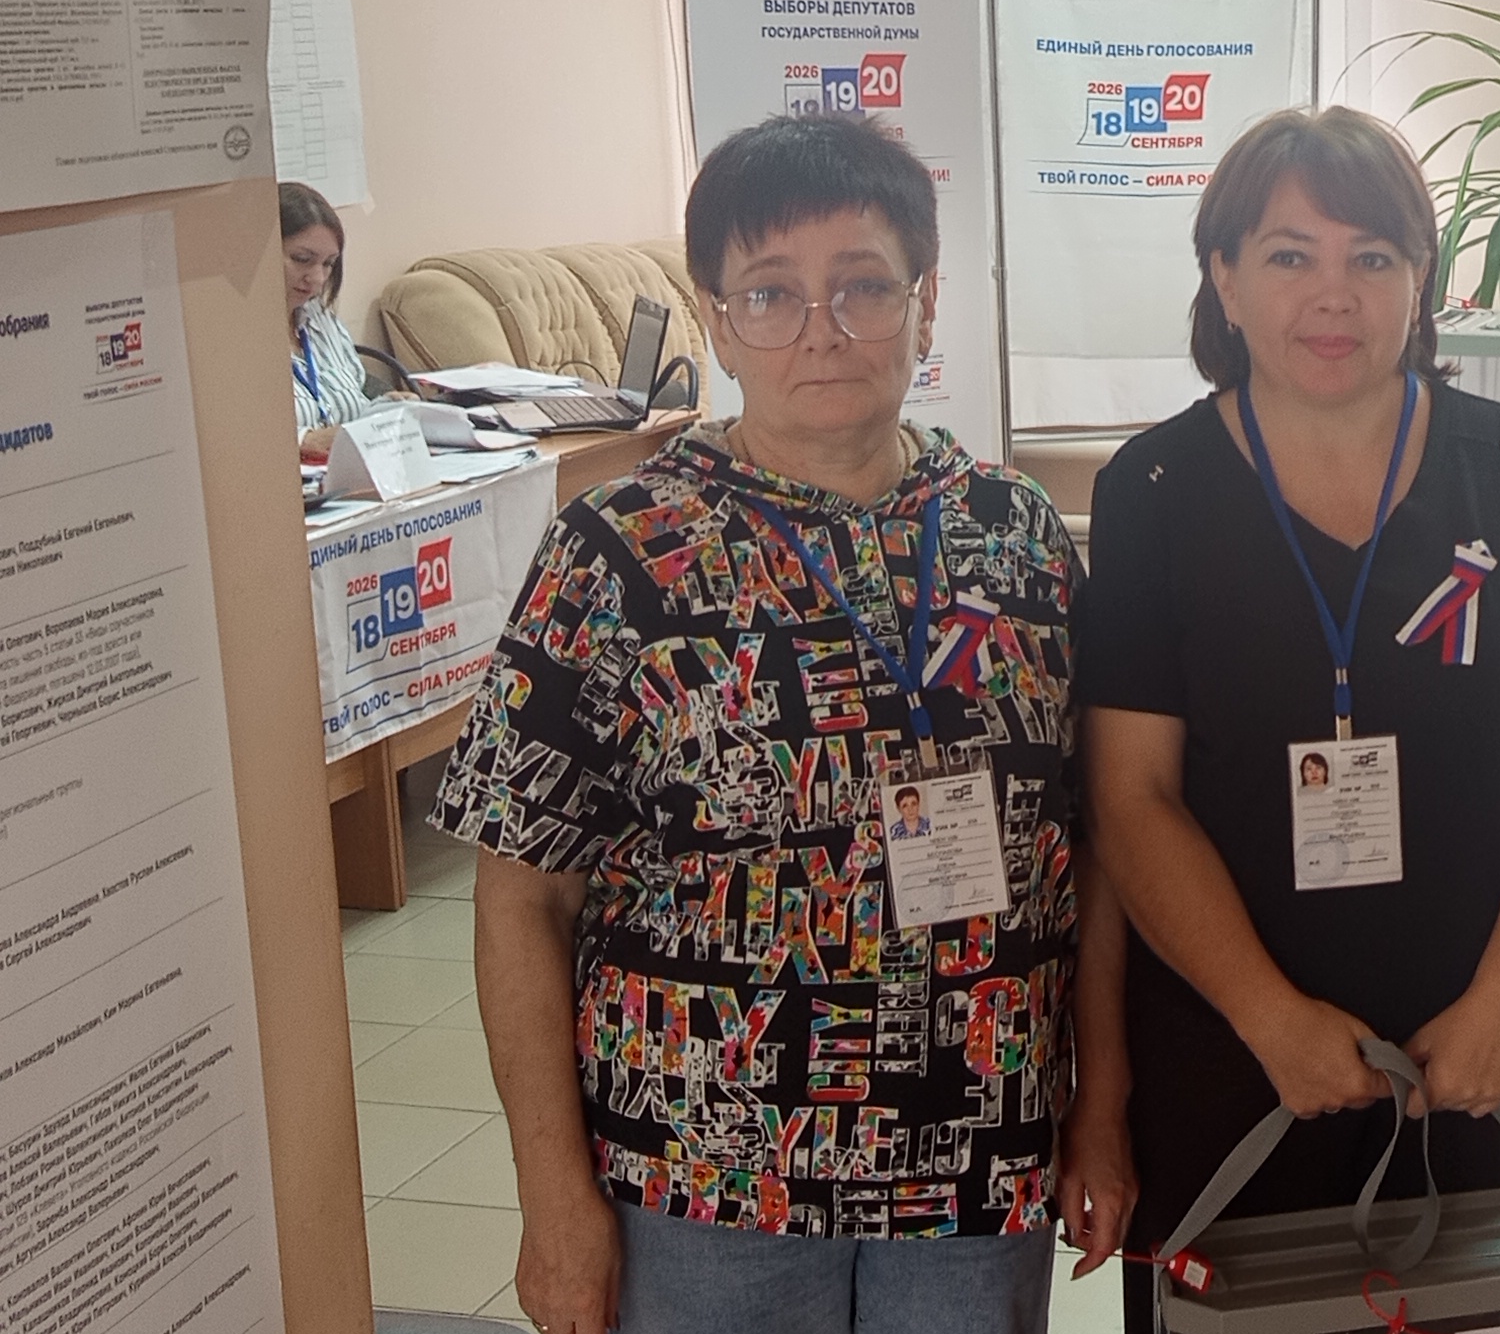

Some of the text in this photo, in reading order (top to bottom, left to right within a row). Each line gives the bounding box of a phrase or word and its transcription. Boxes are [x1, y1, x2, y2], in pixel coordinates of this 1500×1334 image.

[764, 0, 915, 16] ВЫБОРЫ ДЕПУТАТОВ
[762, 26, 919, 40] ГОСУДАРСТВЕННОЙ ДУМЫ
[1036, 39, 1253, 57] ЕДИНЫЙ ДЕНЬ ГОЛОСОВАНИЯ
[785, 66, 819, 78] 2026
[826, 81, 856, 111] 19
[862, 66, 898, 96] 20
[1087, 83, 1123, 95] 2026
[1091, 85, 1201, 136] 18 19 20
[1131, 137, 1203, 149] СЕНТЯБРЯ
[1038, 170, 1076, 184] ТВОЙ
[1079, 173, 1129, 186] ГОЛОС
[1146, 174, 1184, 187] СИЛА
[99, 328, 139, 367] 18 19 20
[310, 500, 483, 569] ДИНЫЙ ДЕНЬ ГОЛОСОВАНИЯ
[347, 574, 378, 597] 2026
[352, 556, 448, 653] 18 19 20
[390, 622, 456, 657] СЕНТЯБРЯ
